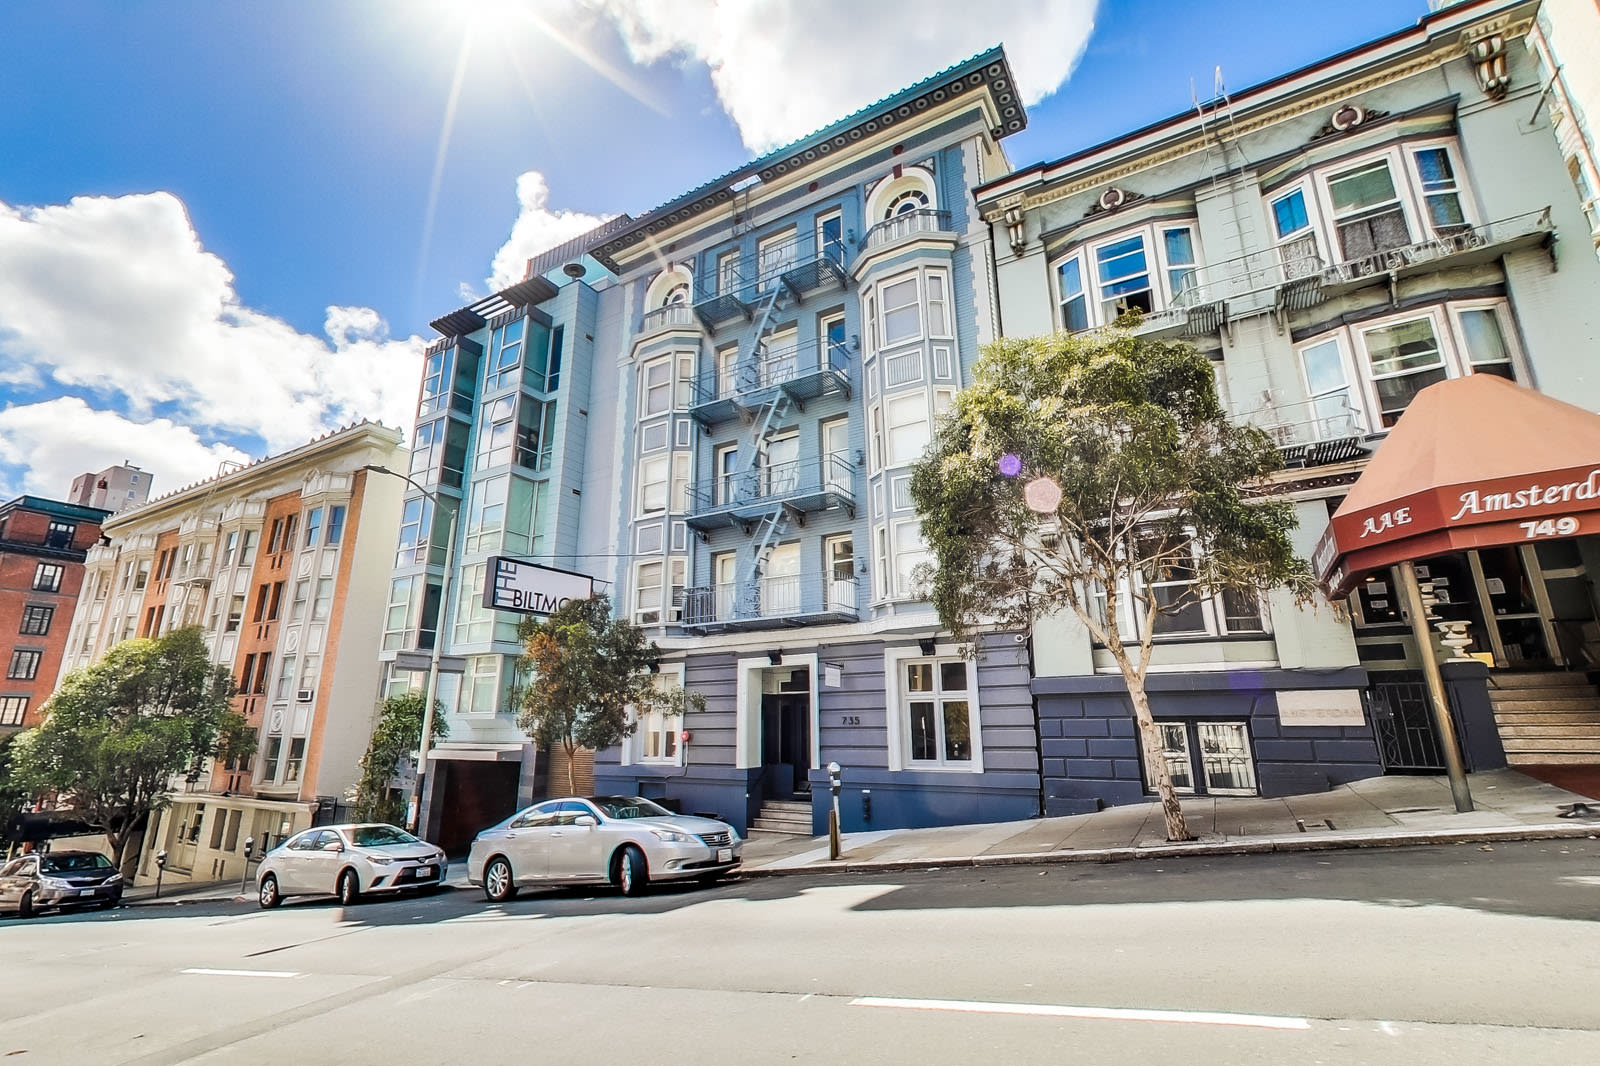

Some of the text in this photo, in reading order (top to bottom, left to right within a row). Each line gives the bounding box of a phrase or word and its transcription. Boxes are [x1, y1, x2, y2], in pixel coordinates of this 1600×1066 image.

[1360, 469, 1600, 538] AAE Amsterd
[1519, 517, 1579, 539] 749
[496, 561, 517, 604] THE
[841, 715, 861, 725] 735
